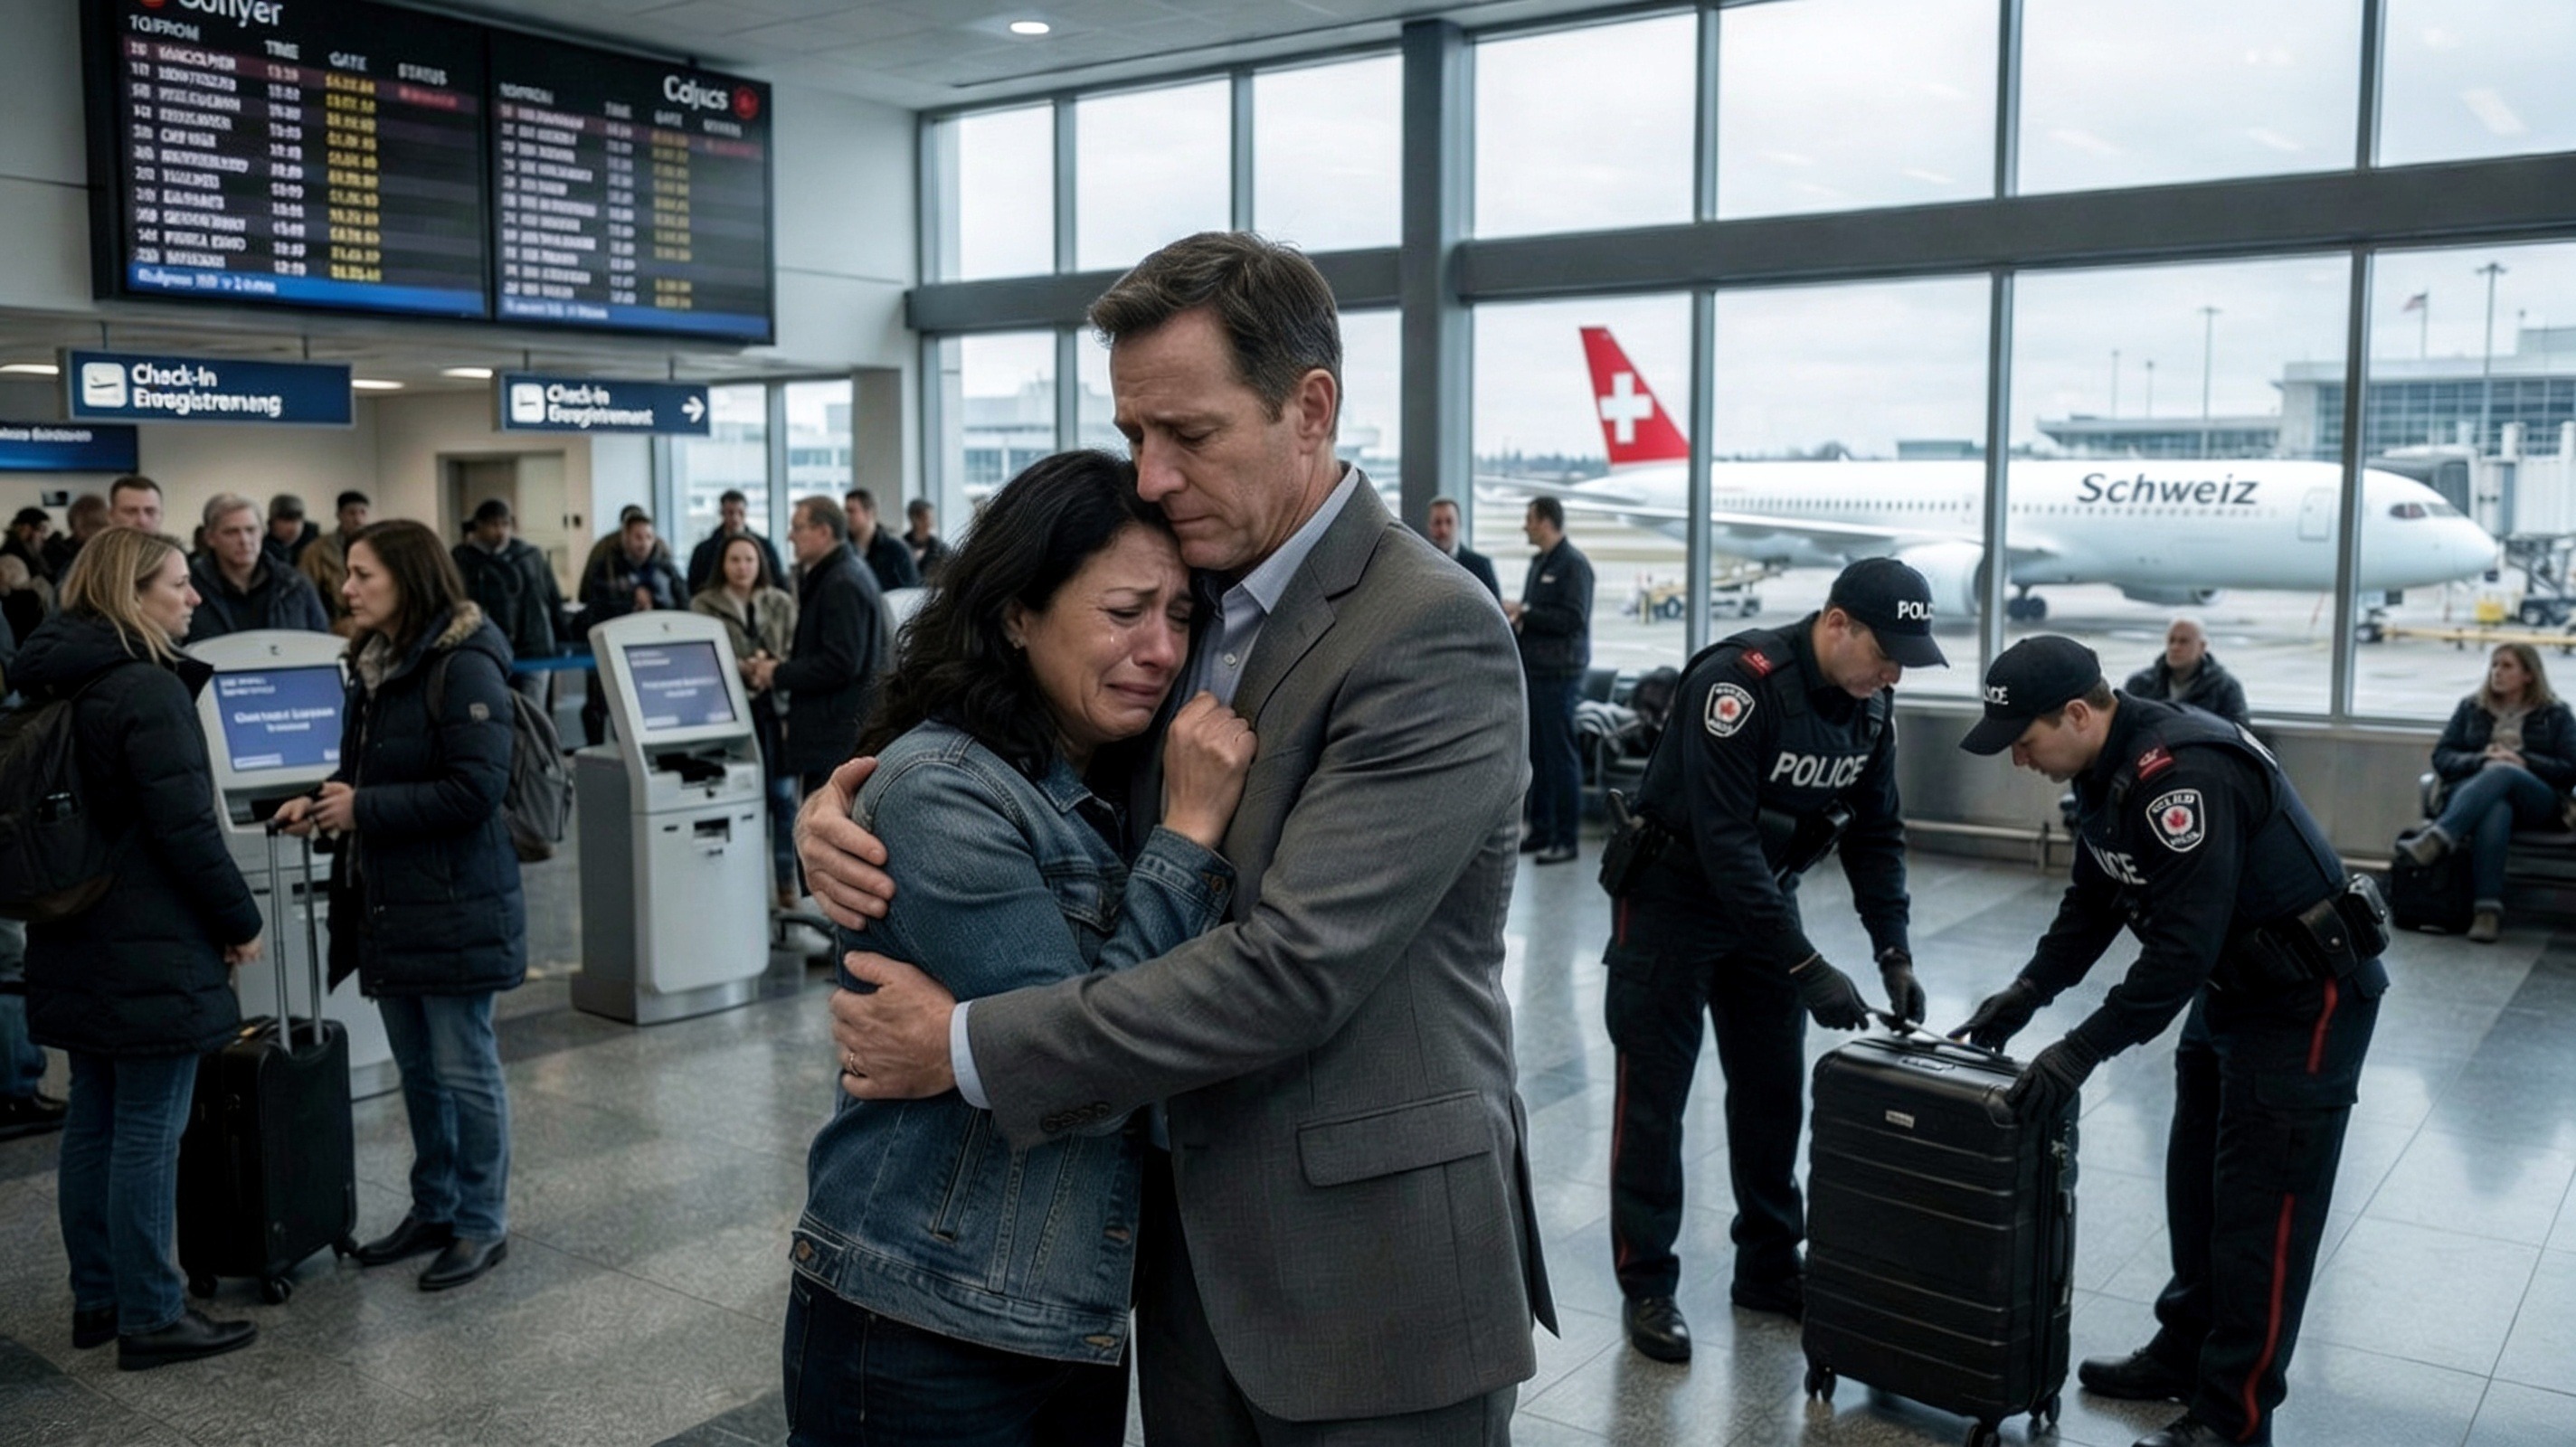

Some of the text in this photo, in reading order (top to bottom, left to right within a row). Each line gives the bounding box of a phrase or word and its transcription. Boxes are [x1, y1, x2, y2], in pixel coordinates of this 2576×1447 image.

[329, 51, 366, 71] GATE
[2078, 472, 2259, 505] Schweiz
[1769, 751, 1869, 789] POLICE
